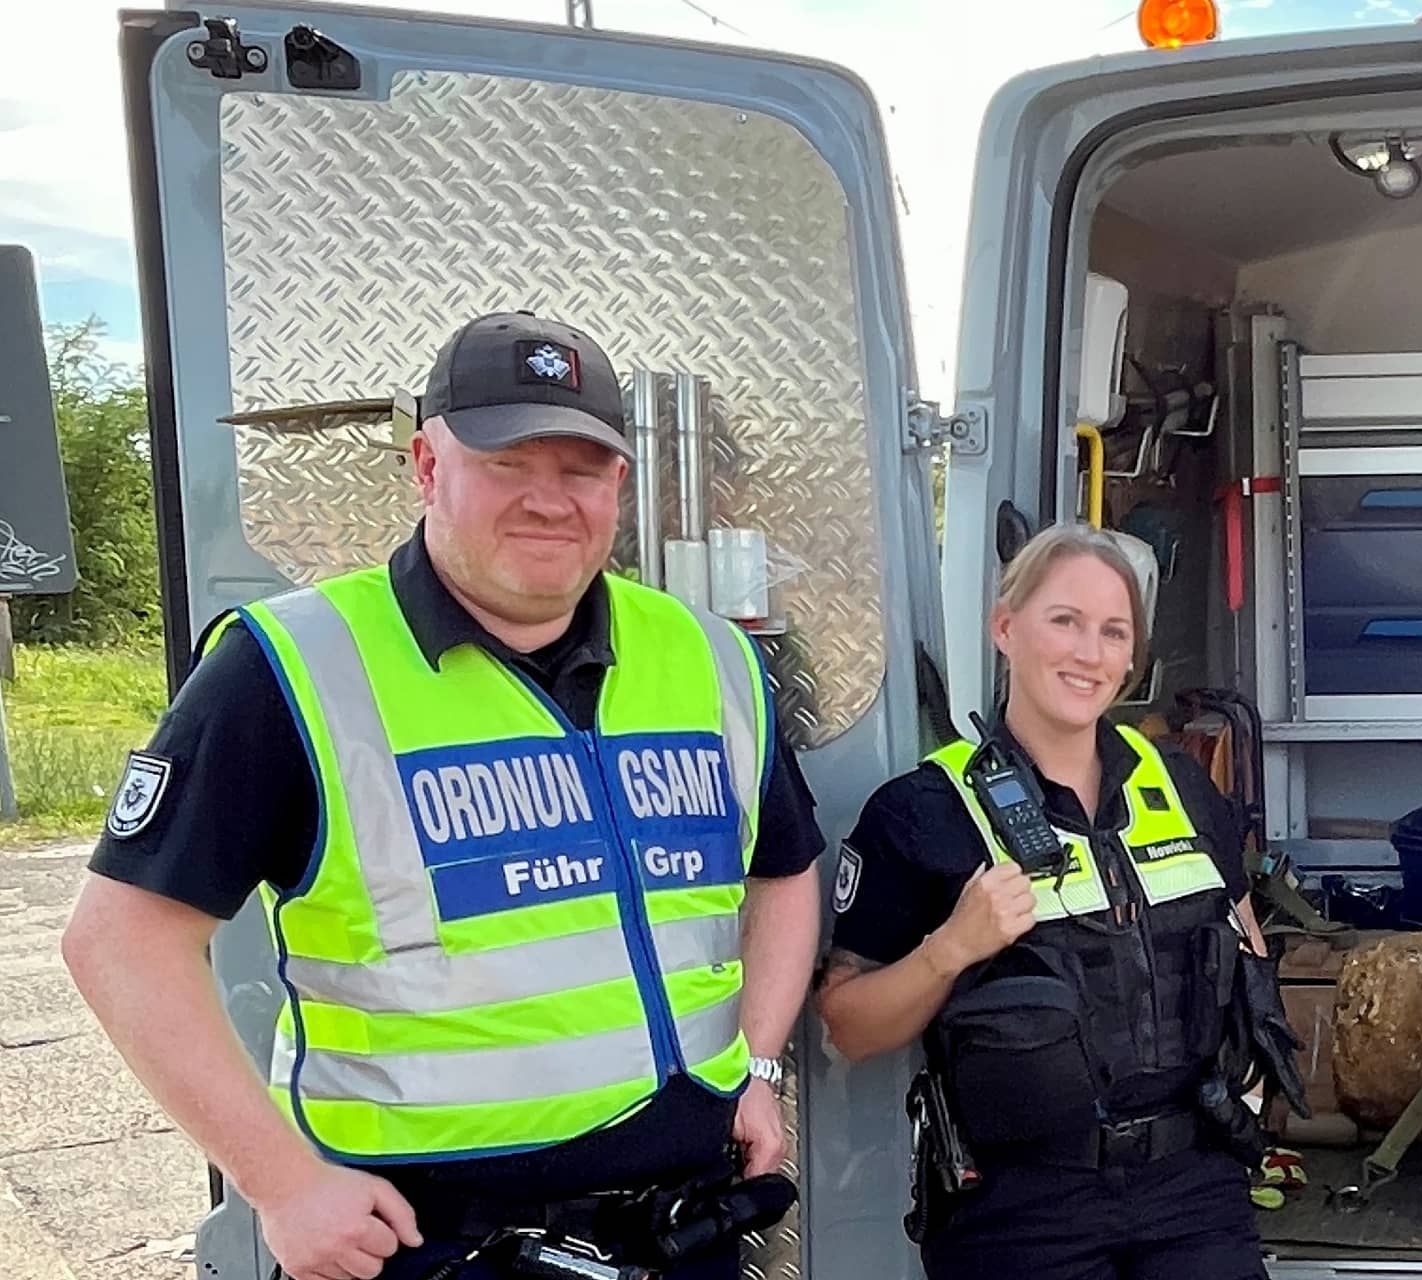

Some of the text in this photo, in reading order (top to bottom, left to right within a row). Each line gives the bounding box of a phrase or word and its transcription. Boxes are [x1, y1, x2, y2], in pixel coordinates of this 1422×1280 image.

[412, 748, 727, 844] ORDNUN GSAMT
[503, 846, 704, 895] Führ Grp
